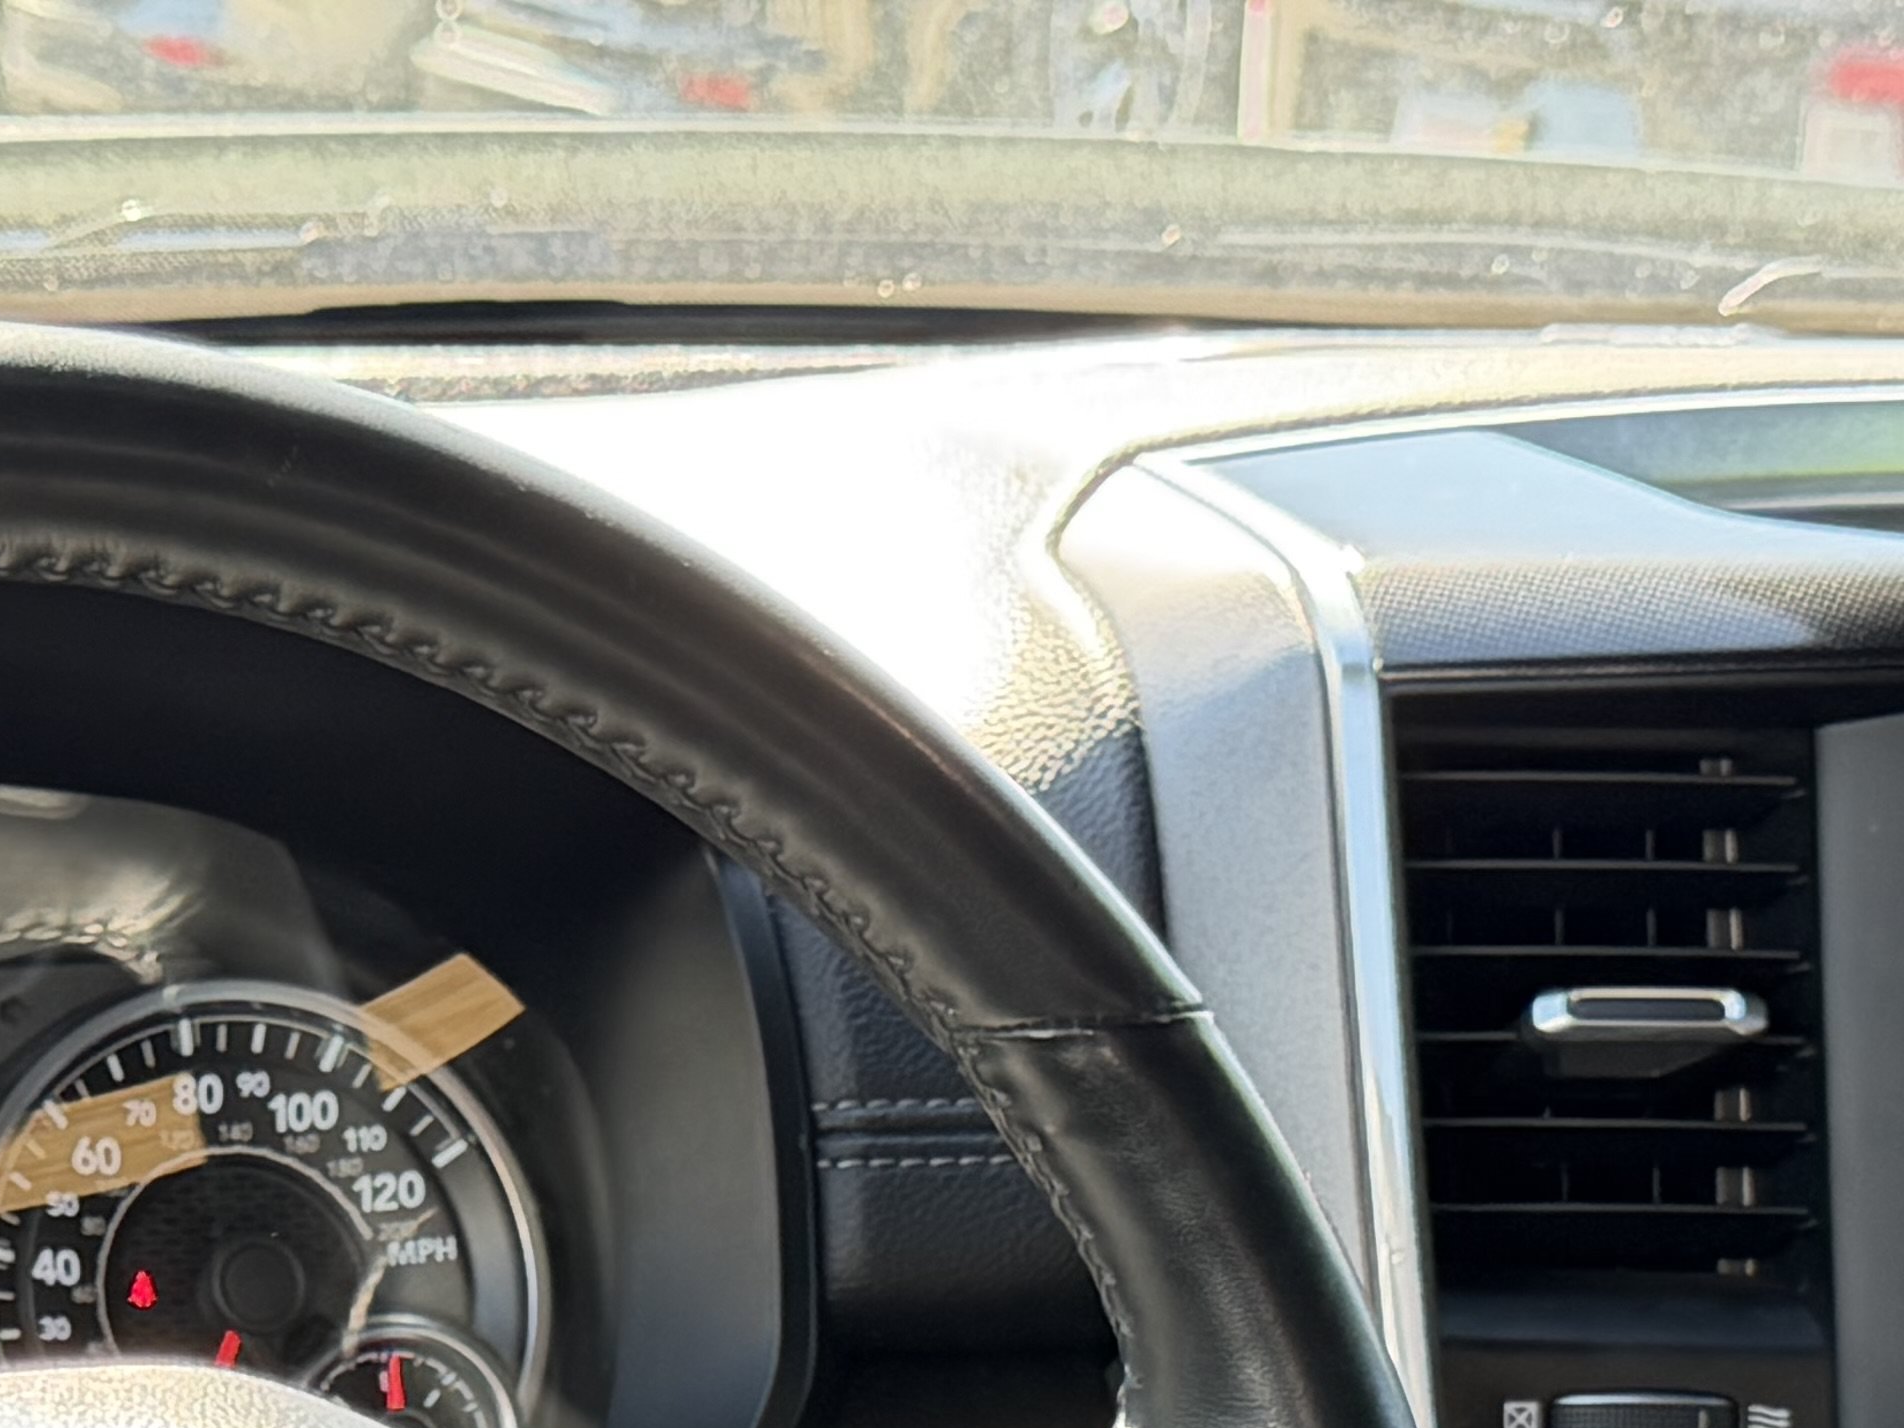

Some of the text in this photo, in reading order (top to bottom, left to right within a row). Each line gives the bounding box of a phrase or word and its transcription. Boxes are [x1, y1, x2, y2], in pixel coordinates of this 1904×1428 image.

[172, 1072, 224, 1115] 80
[236, 1070, 271, 1098] 90
[123, 1099, 157, 1127] 70
[267, 1090, 339, 1133] 100
[343, 1123, 388, 1152] 110
[71, 1136, 122, 1176] 60
[352, 1169, 427, 1213] 120
[31, 1249, 81, 1287] 40
[386, 1234, 459, 1267] MPH
[37, 1315, 72, 1342] 30
